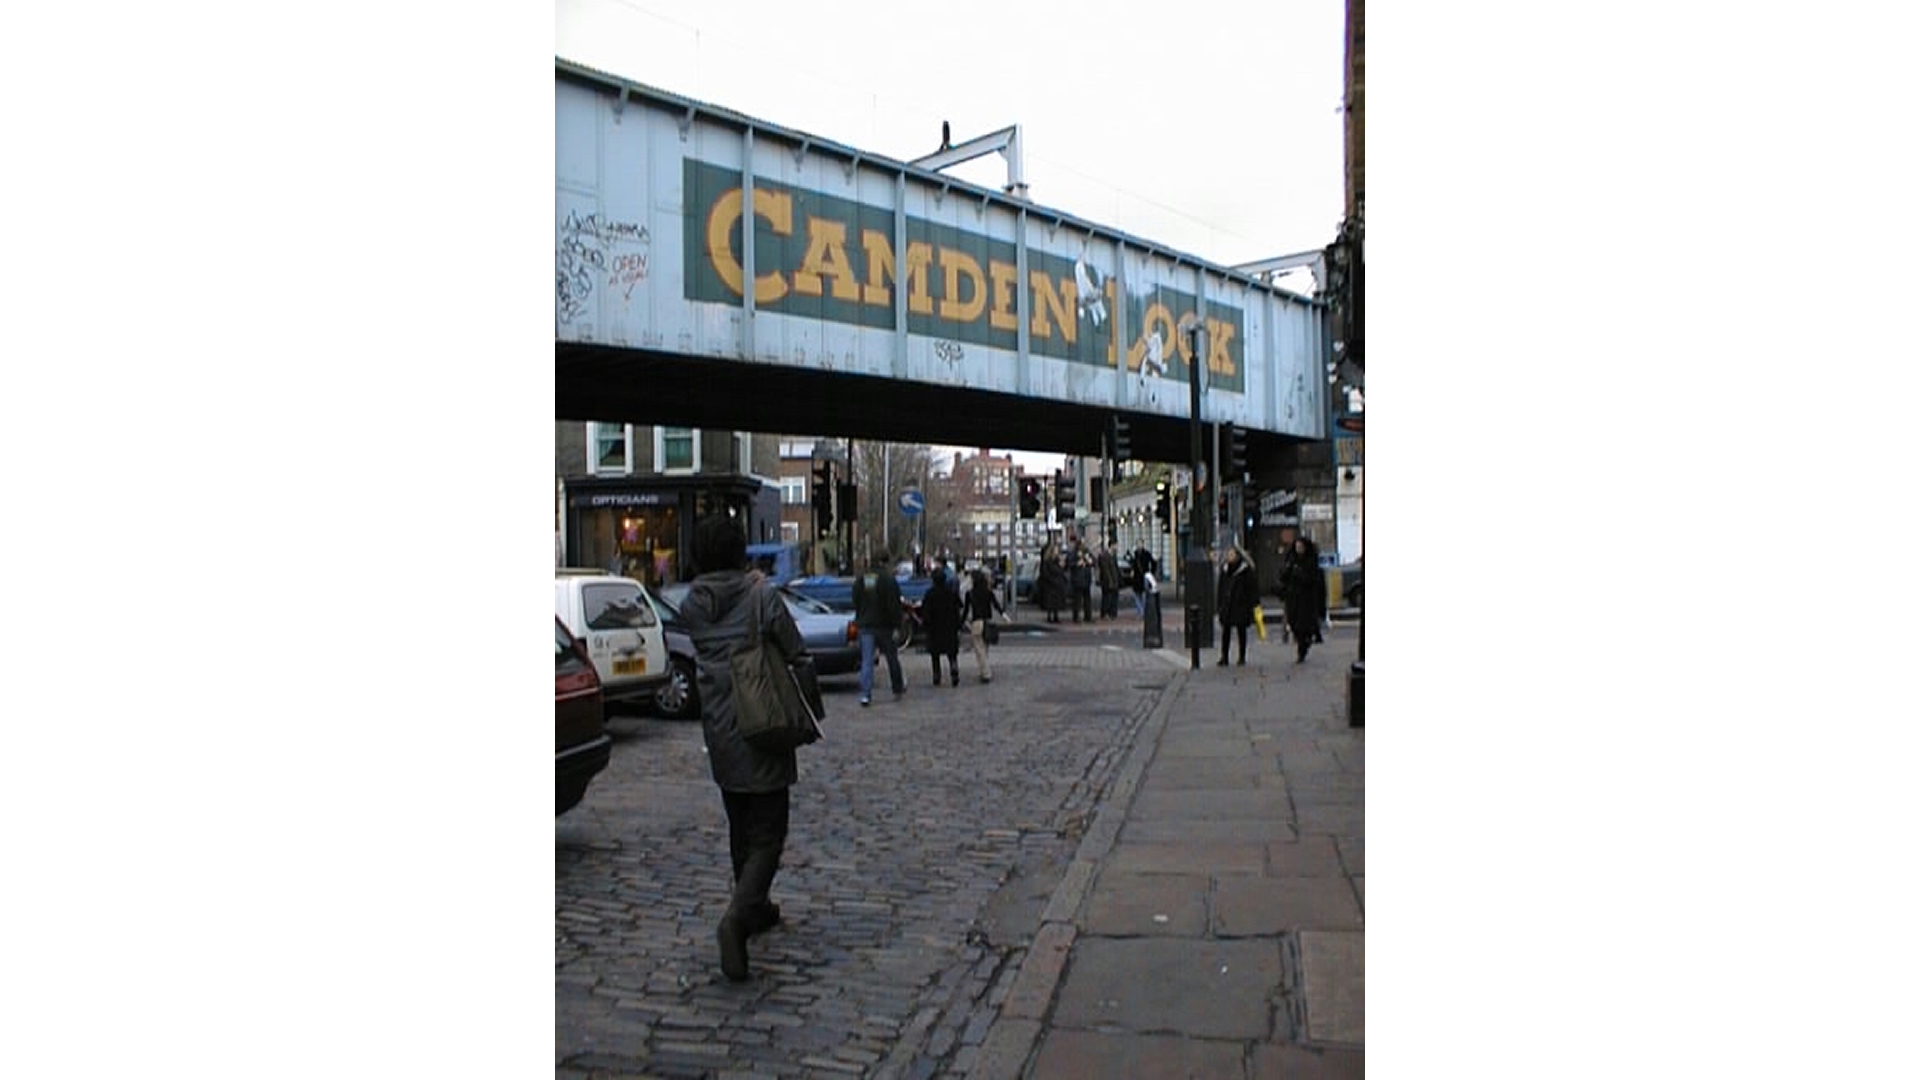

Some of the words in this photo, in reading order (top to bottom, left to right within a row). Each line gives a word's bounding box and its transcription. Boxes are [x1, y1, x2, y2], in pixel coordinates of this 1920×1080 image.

[613, 254, 648, 272] OPEN
[708, 187, 1077, 343] CAMDEN
[592, 495, 659, 505] OPTICIANS
